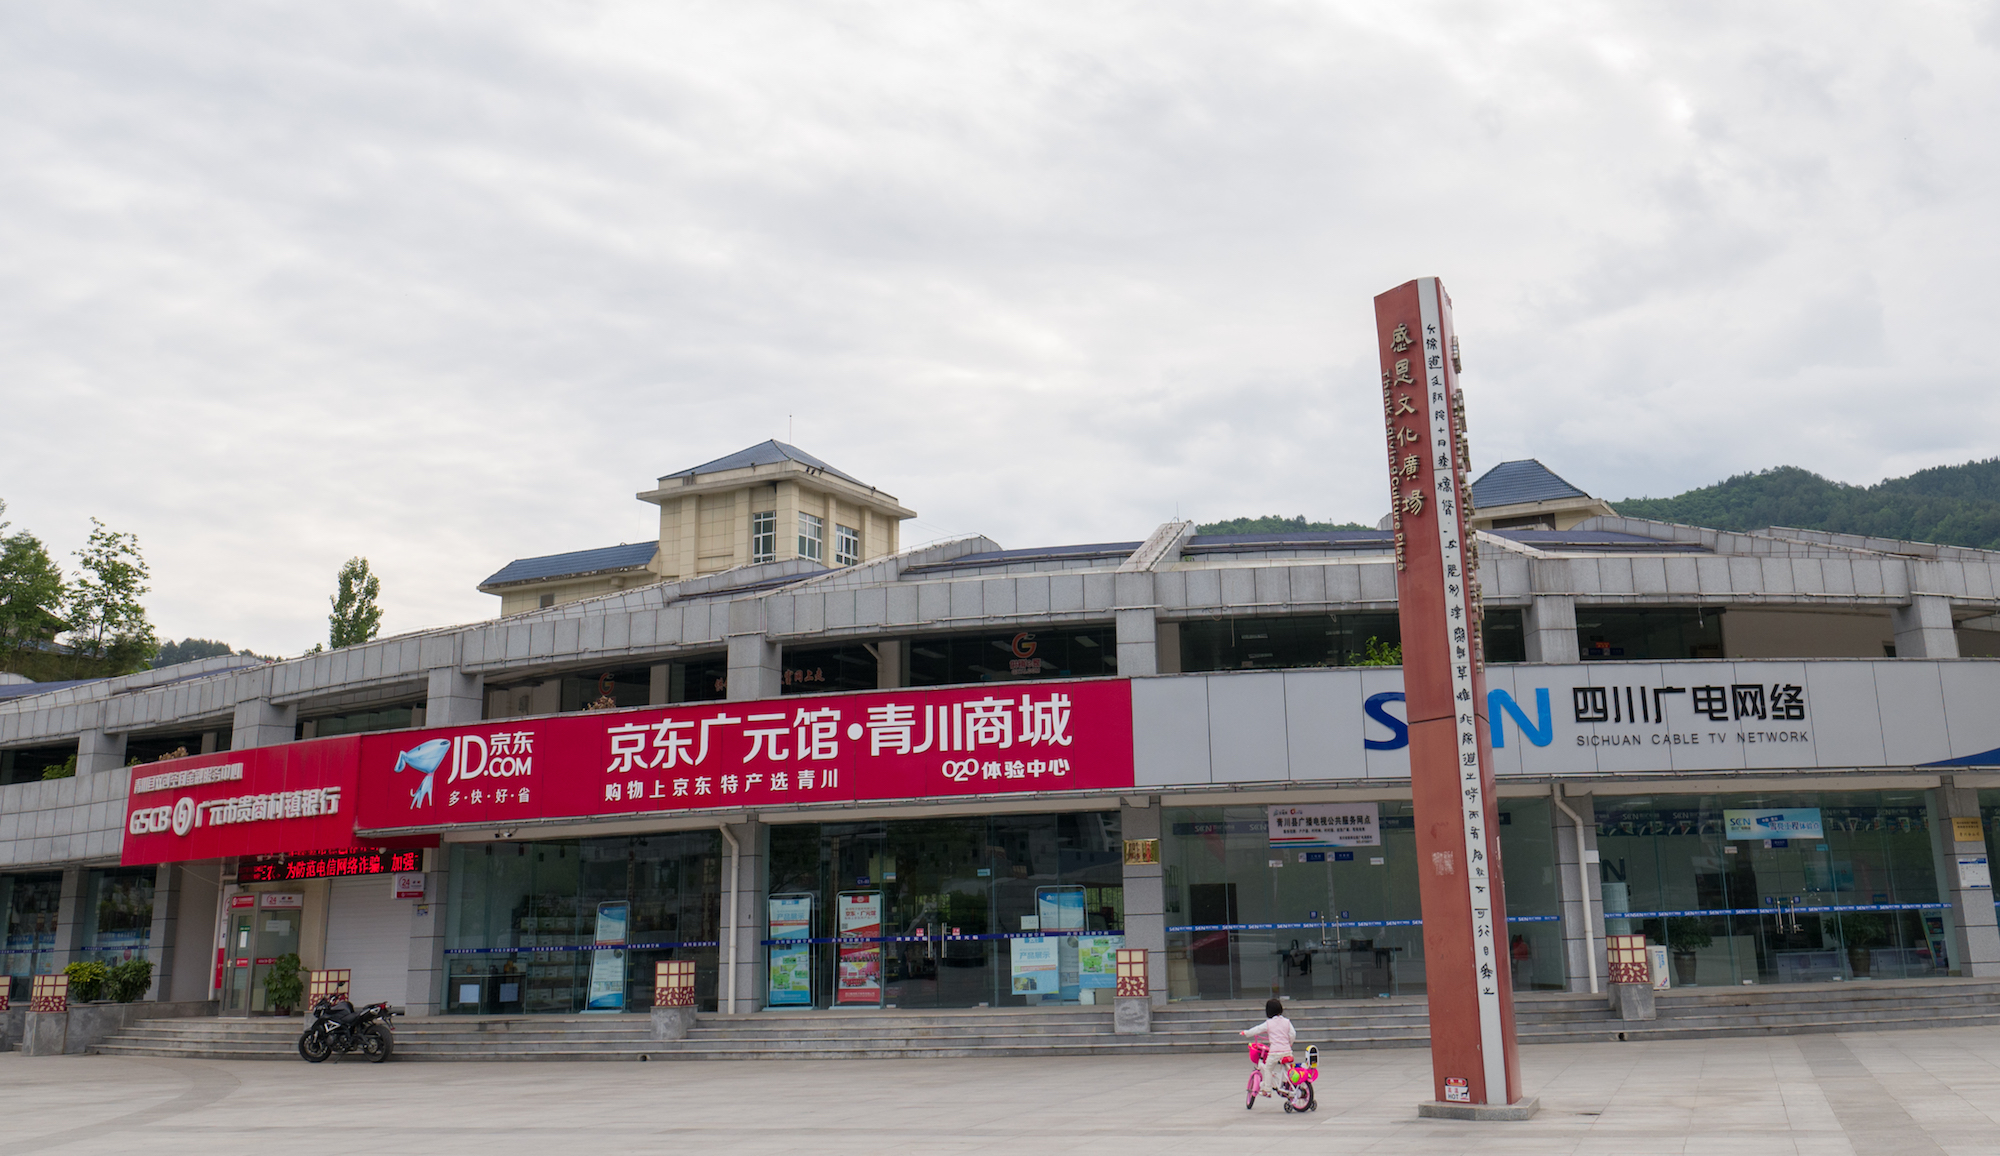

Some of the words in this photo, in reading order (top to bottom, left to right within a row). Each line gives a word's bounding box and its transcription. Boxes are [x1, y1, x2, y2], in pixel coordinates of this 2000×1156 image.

[1395, 532, 1405, 571] Plaza
[1364, 687, 1553, 750] SN
[1572, 684, 1805, 722] 四川广电网络
[489, 731, 535, 755] 京东
[606, 692, 1073, 774] 京东广元馆·青川商城
[1577, 735, 1641, 746] SICHUAN
[1651, 733, 1699, 745] CABLE
[1708, 732, 1727, 744] TV
[1736, 731, 1808, 743] NETWORK
[129, 806, 172, 835] GSCB
[194, 786, 341, 828] 广元市贵商村镇银行
[1276, 815, 1371, 827] 青川县广播电视公共服务网点
[1019, 951, 1050, 959] 产品展示
